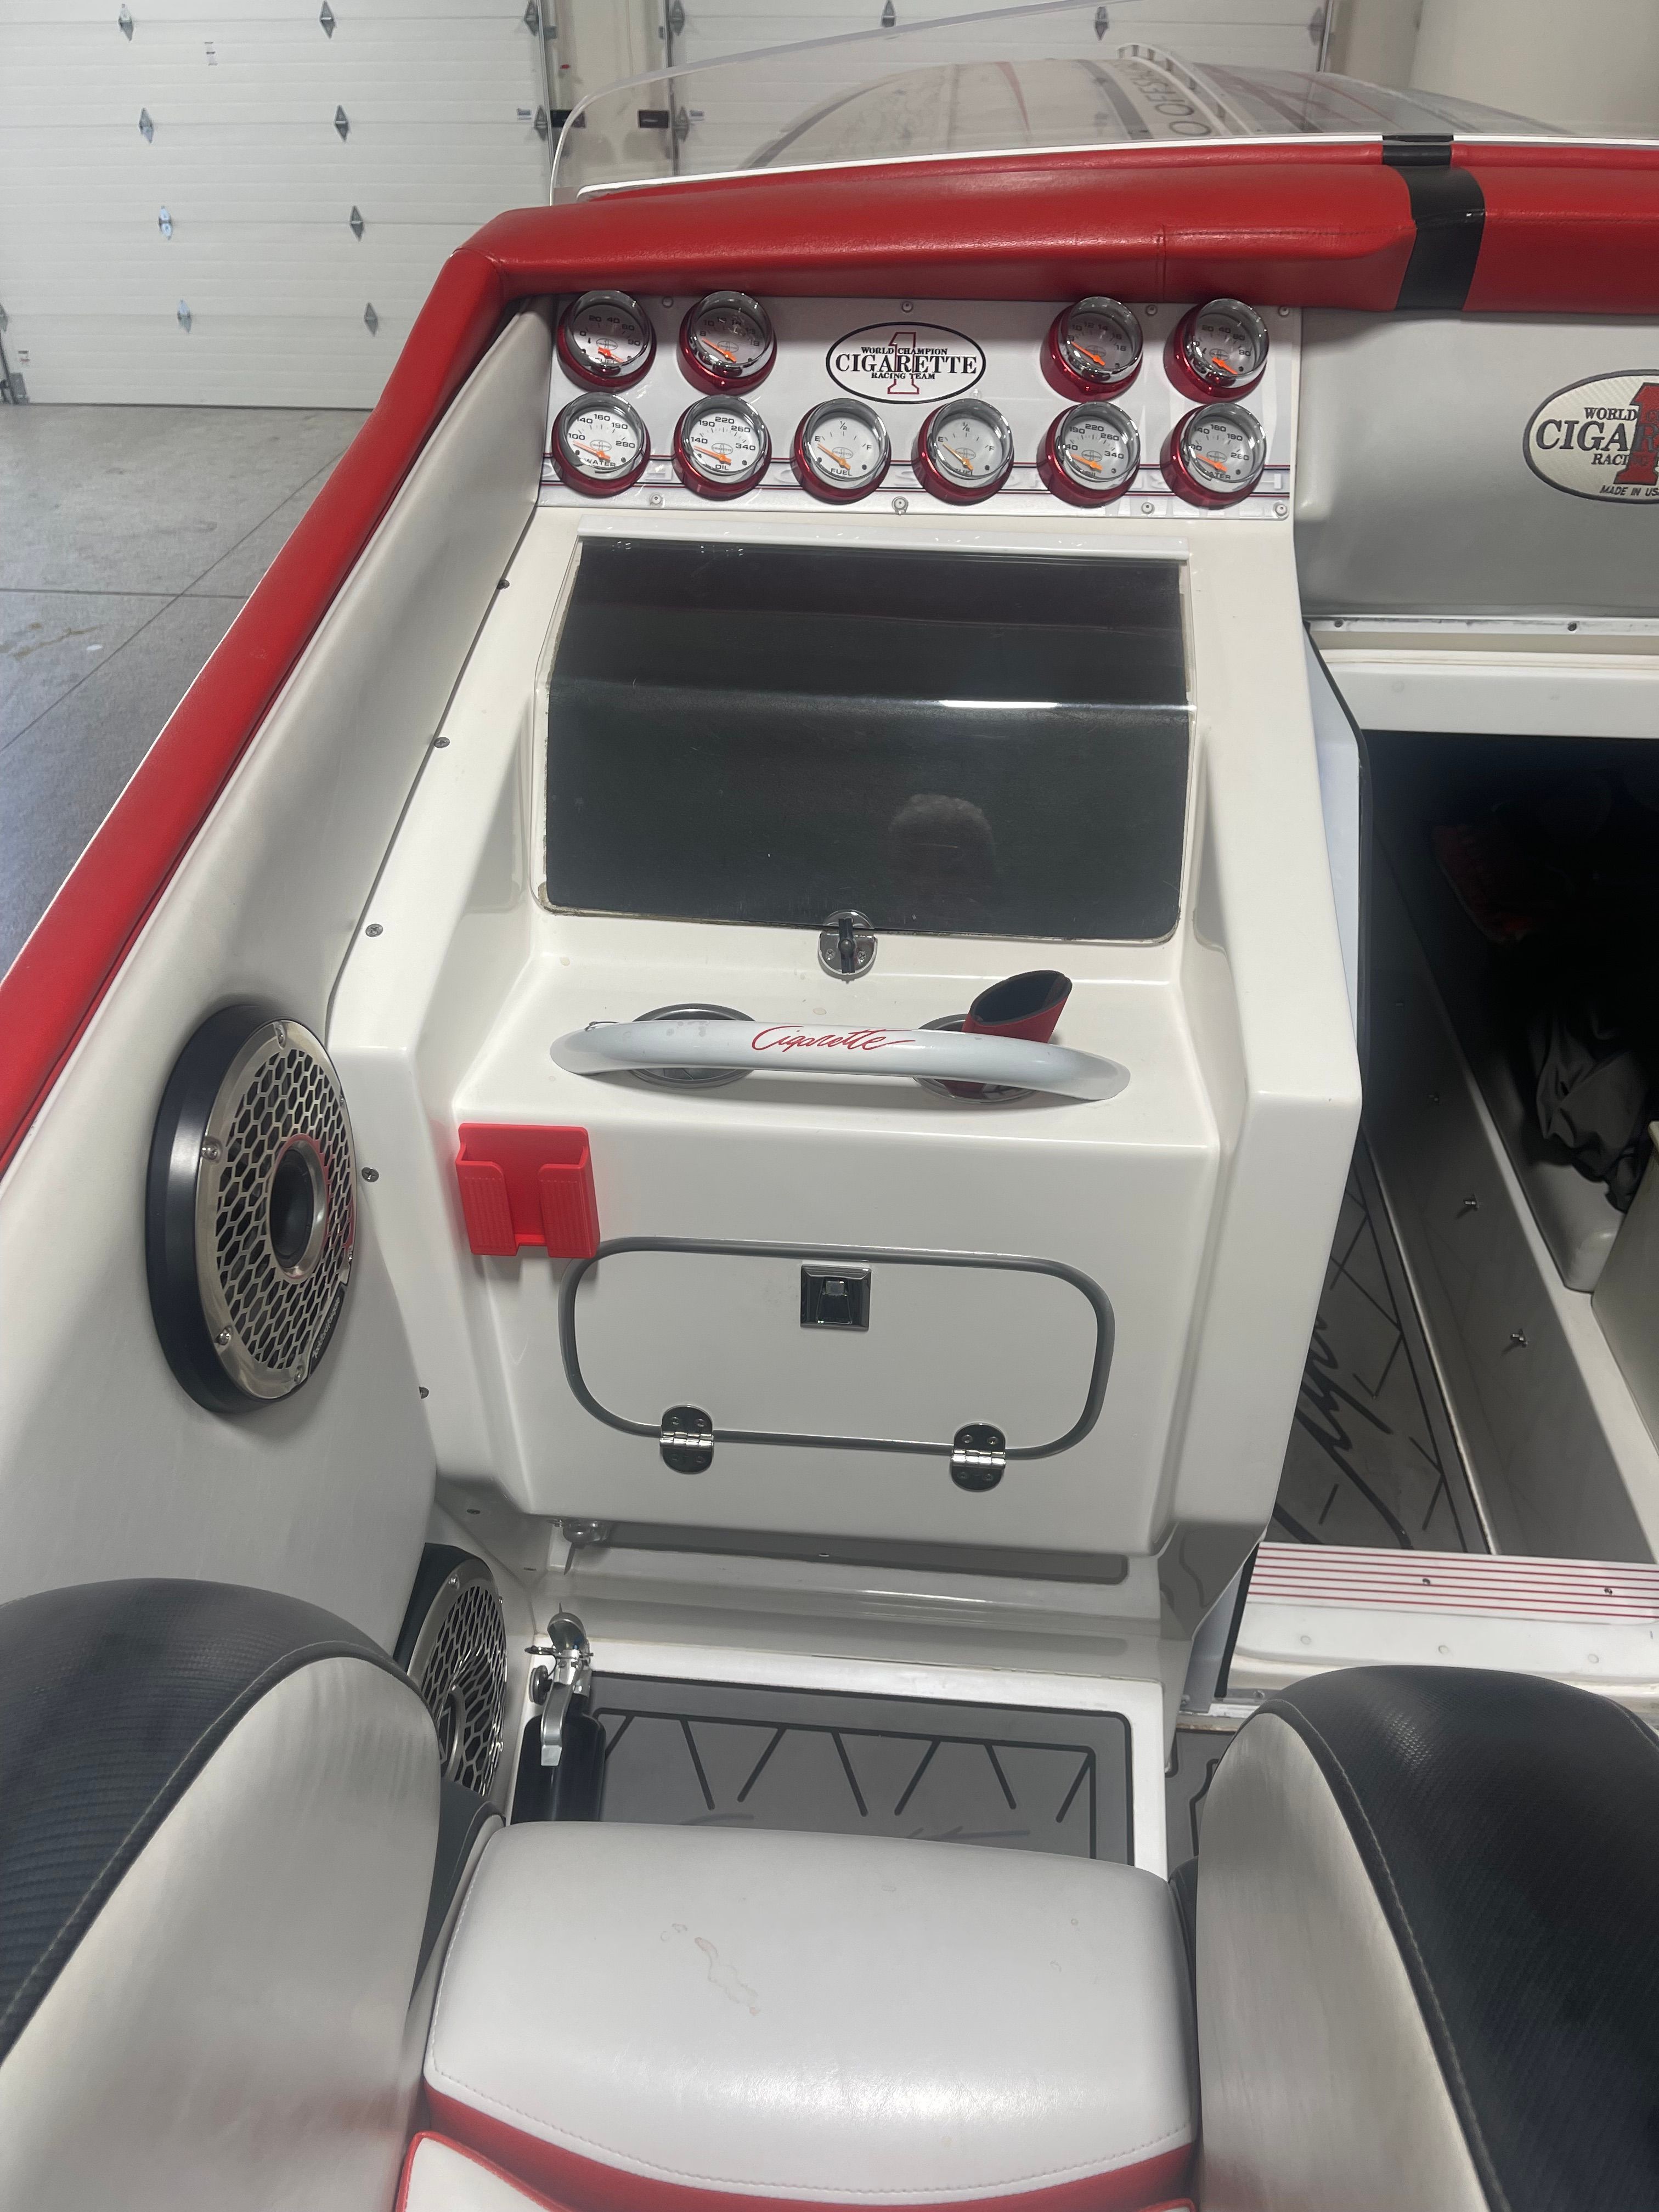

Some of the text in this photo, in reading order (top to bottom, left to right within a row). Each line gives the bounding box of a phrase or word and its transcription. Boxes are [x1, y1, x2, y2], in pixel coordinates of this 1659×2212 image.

[861, 346, 948, 356] WORLD CHAMPION
[836, 353, 977, 374] CIGARETTE
[1584, 407, 1638, 421] WORLD
[1085, 424, 1104, 432] 220
[1101, 433, 1119, 441] 260
[736, 443, 755, 451] 340
[1104, 450, 1124, 459] 340
[1231, 452, 1249, 461] 280
[584, 457, 616, 467] WATER
[831, 468, 853, 476] FUEL
[1599, 485, 1628, 496] MADE
[1630, 487, 1641, 496] IN
[752, 1025, 916, 1052] Cigarette
